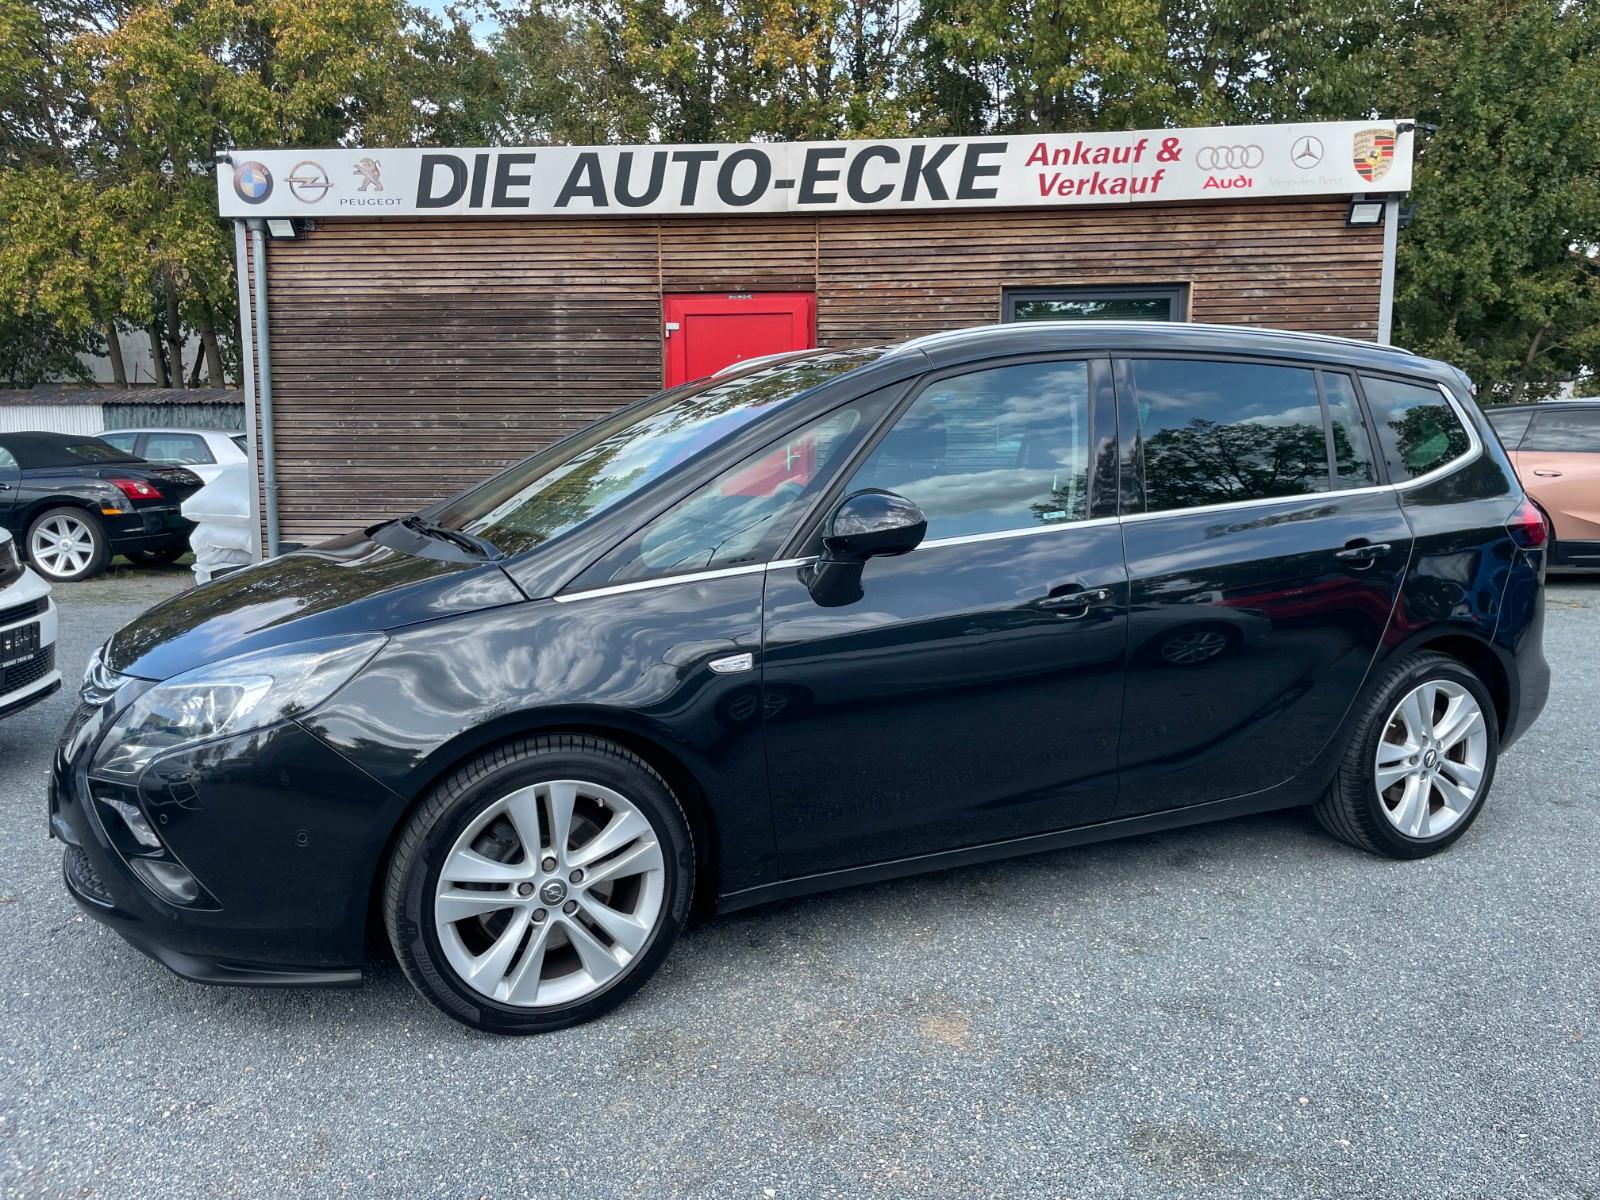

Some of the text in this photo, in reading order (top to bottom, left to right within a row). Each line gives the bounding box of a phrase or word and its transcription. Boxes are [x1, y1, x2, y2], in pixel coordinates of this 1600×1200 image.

[1025, 136, 1183, 168] Ankauf &
[415, 141, 1009, 209] DIE AUTO-ECKE
[1038, 169, 1166, 198] Verkauf
[1202, 175, 1253, 190] Audi
[339, 198, 403, 206] PEUGEOT
